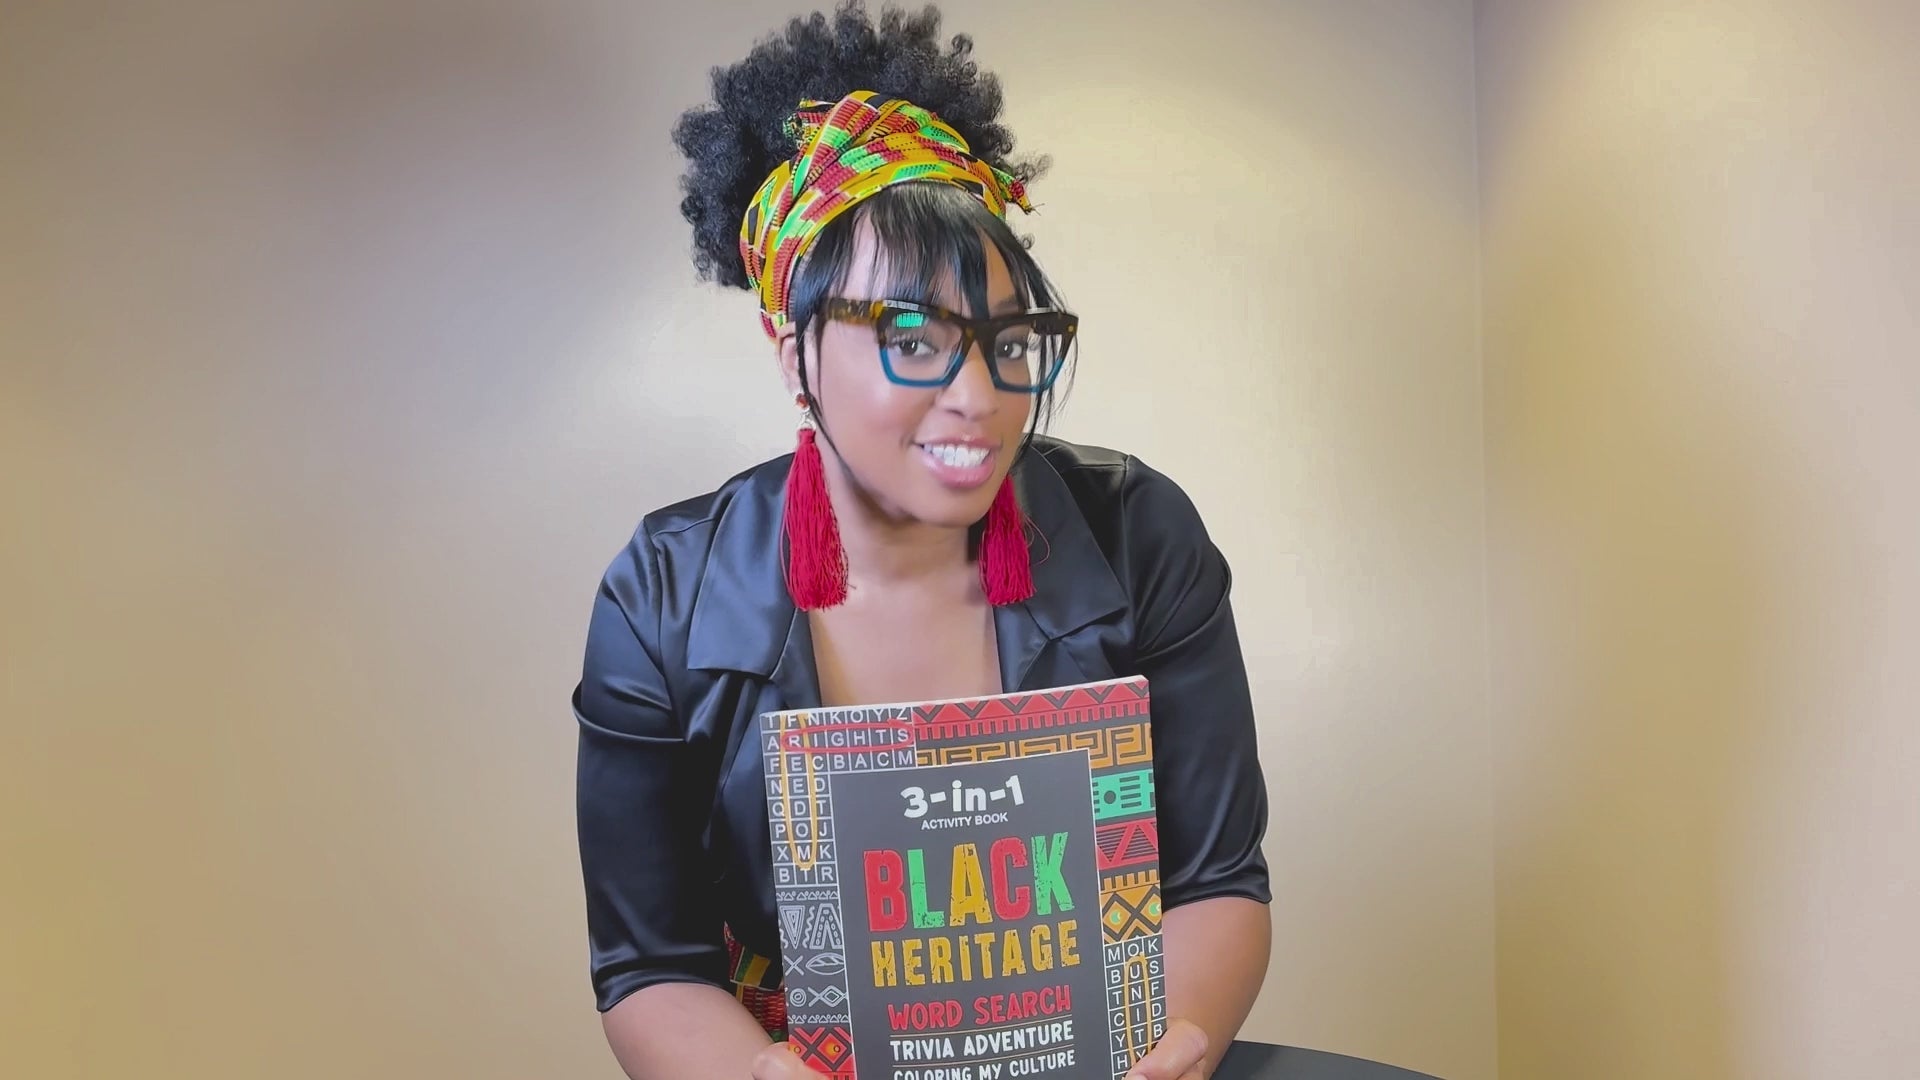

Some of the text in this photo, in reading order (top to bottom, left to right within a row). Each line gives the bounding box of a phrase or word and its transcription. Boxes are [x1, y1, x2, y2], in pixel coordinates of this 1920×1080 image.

[900, 774, 1025, 818] 3-in-1
[921, 812, 1009, 831] ACTIVITY BOOK
[863, 832, 1076, 932] BLACK
[871, 920, 1081, 987] HERITAGE
[888, 984, 1072, 1031] WORD SEARCH
[890, 1020, 1074, 1061] TRIVIA ADVENTURE
[979, 1063, 1002, 1080] MY
[1009, 1050, 1076, 1077] CULTURE
